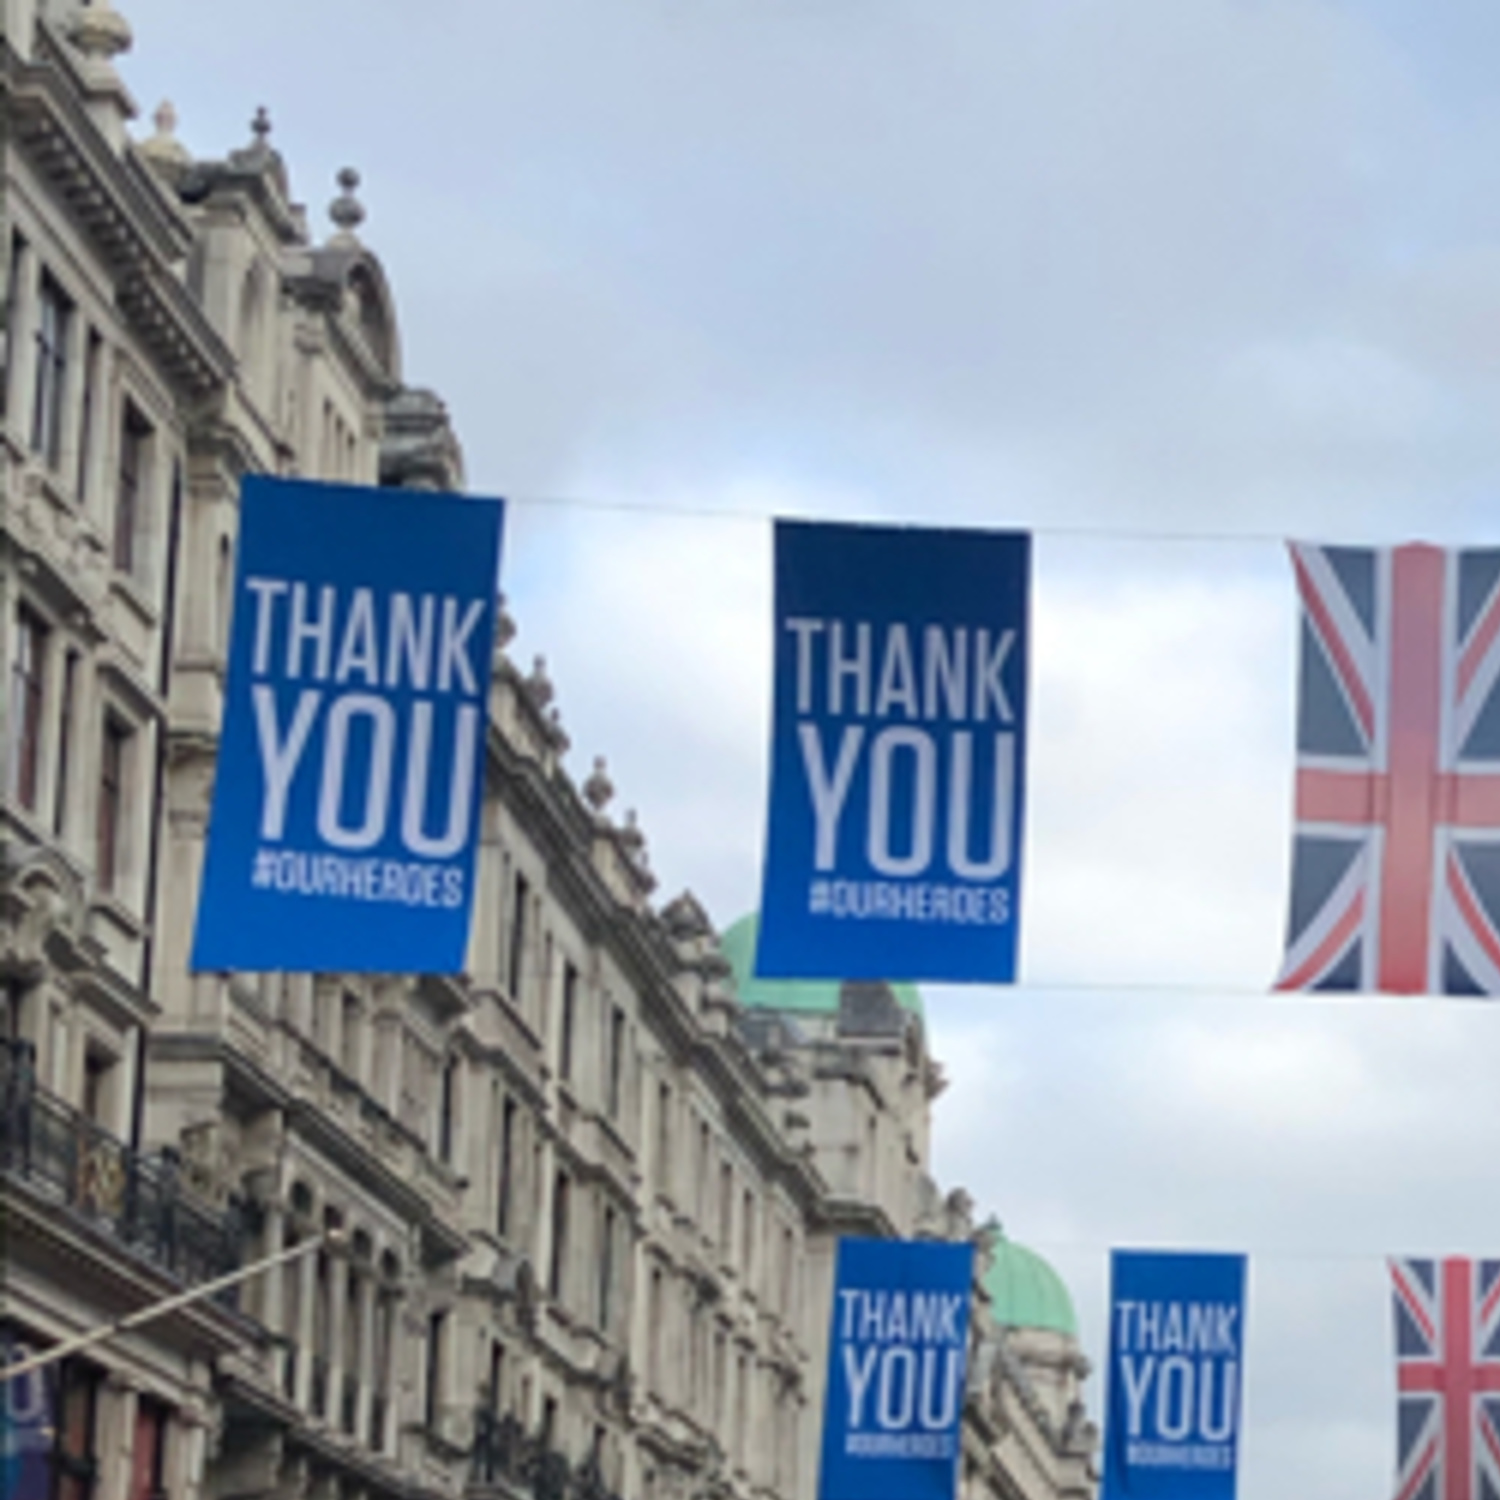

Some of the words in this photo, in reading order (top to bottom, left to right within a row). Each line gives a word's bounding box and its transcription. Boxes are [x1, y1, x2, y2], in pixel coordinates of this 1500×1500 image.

[248, 578, 485, 695] THANK
[786, 618, 1015, 723] THANK
[252, 686, 479, 858] YOU
[799, 724, 1014, 879] YOU
[252, 847, 463, 908] #OURHEROES
[809, 872, 1008, 924] #OURHEROES
[840, 1289, 960, 1343] THANK
[1116, 1300, 1236, 1353] THANK
[844, 1344, 959, 1429] YOU
[1120, 1355, 1236, 1441] YOU
